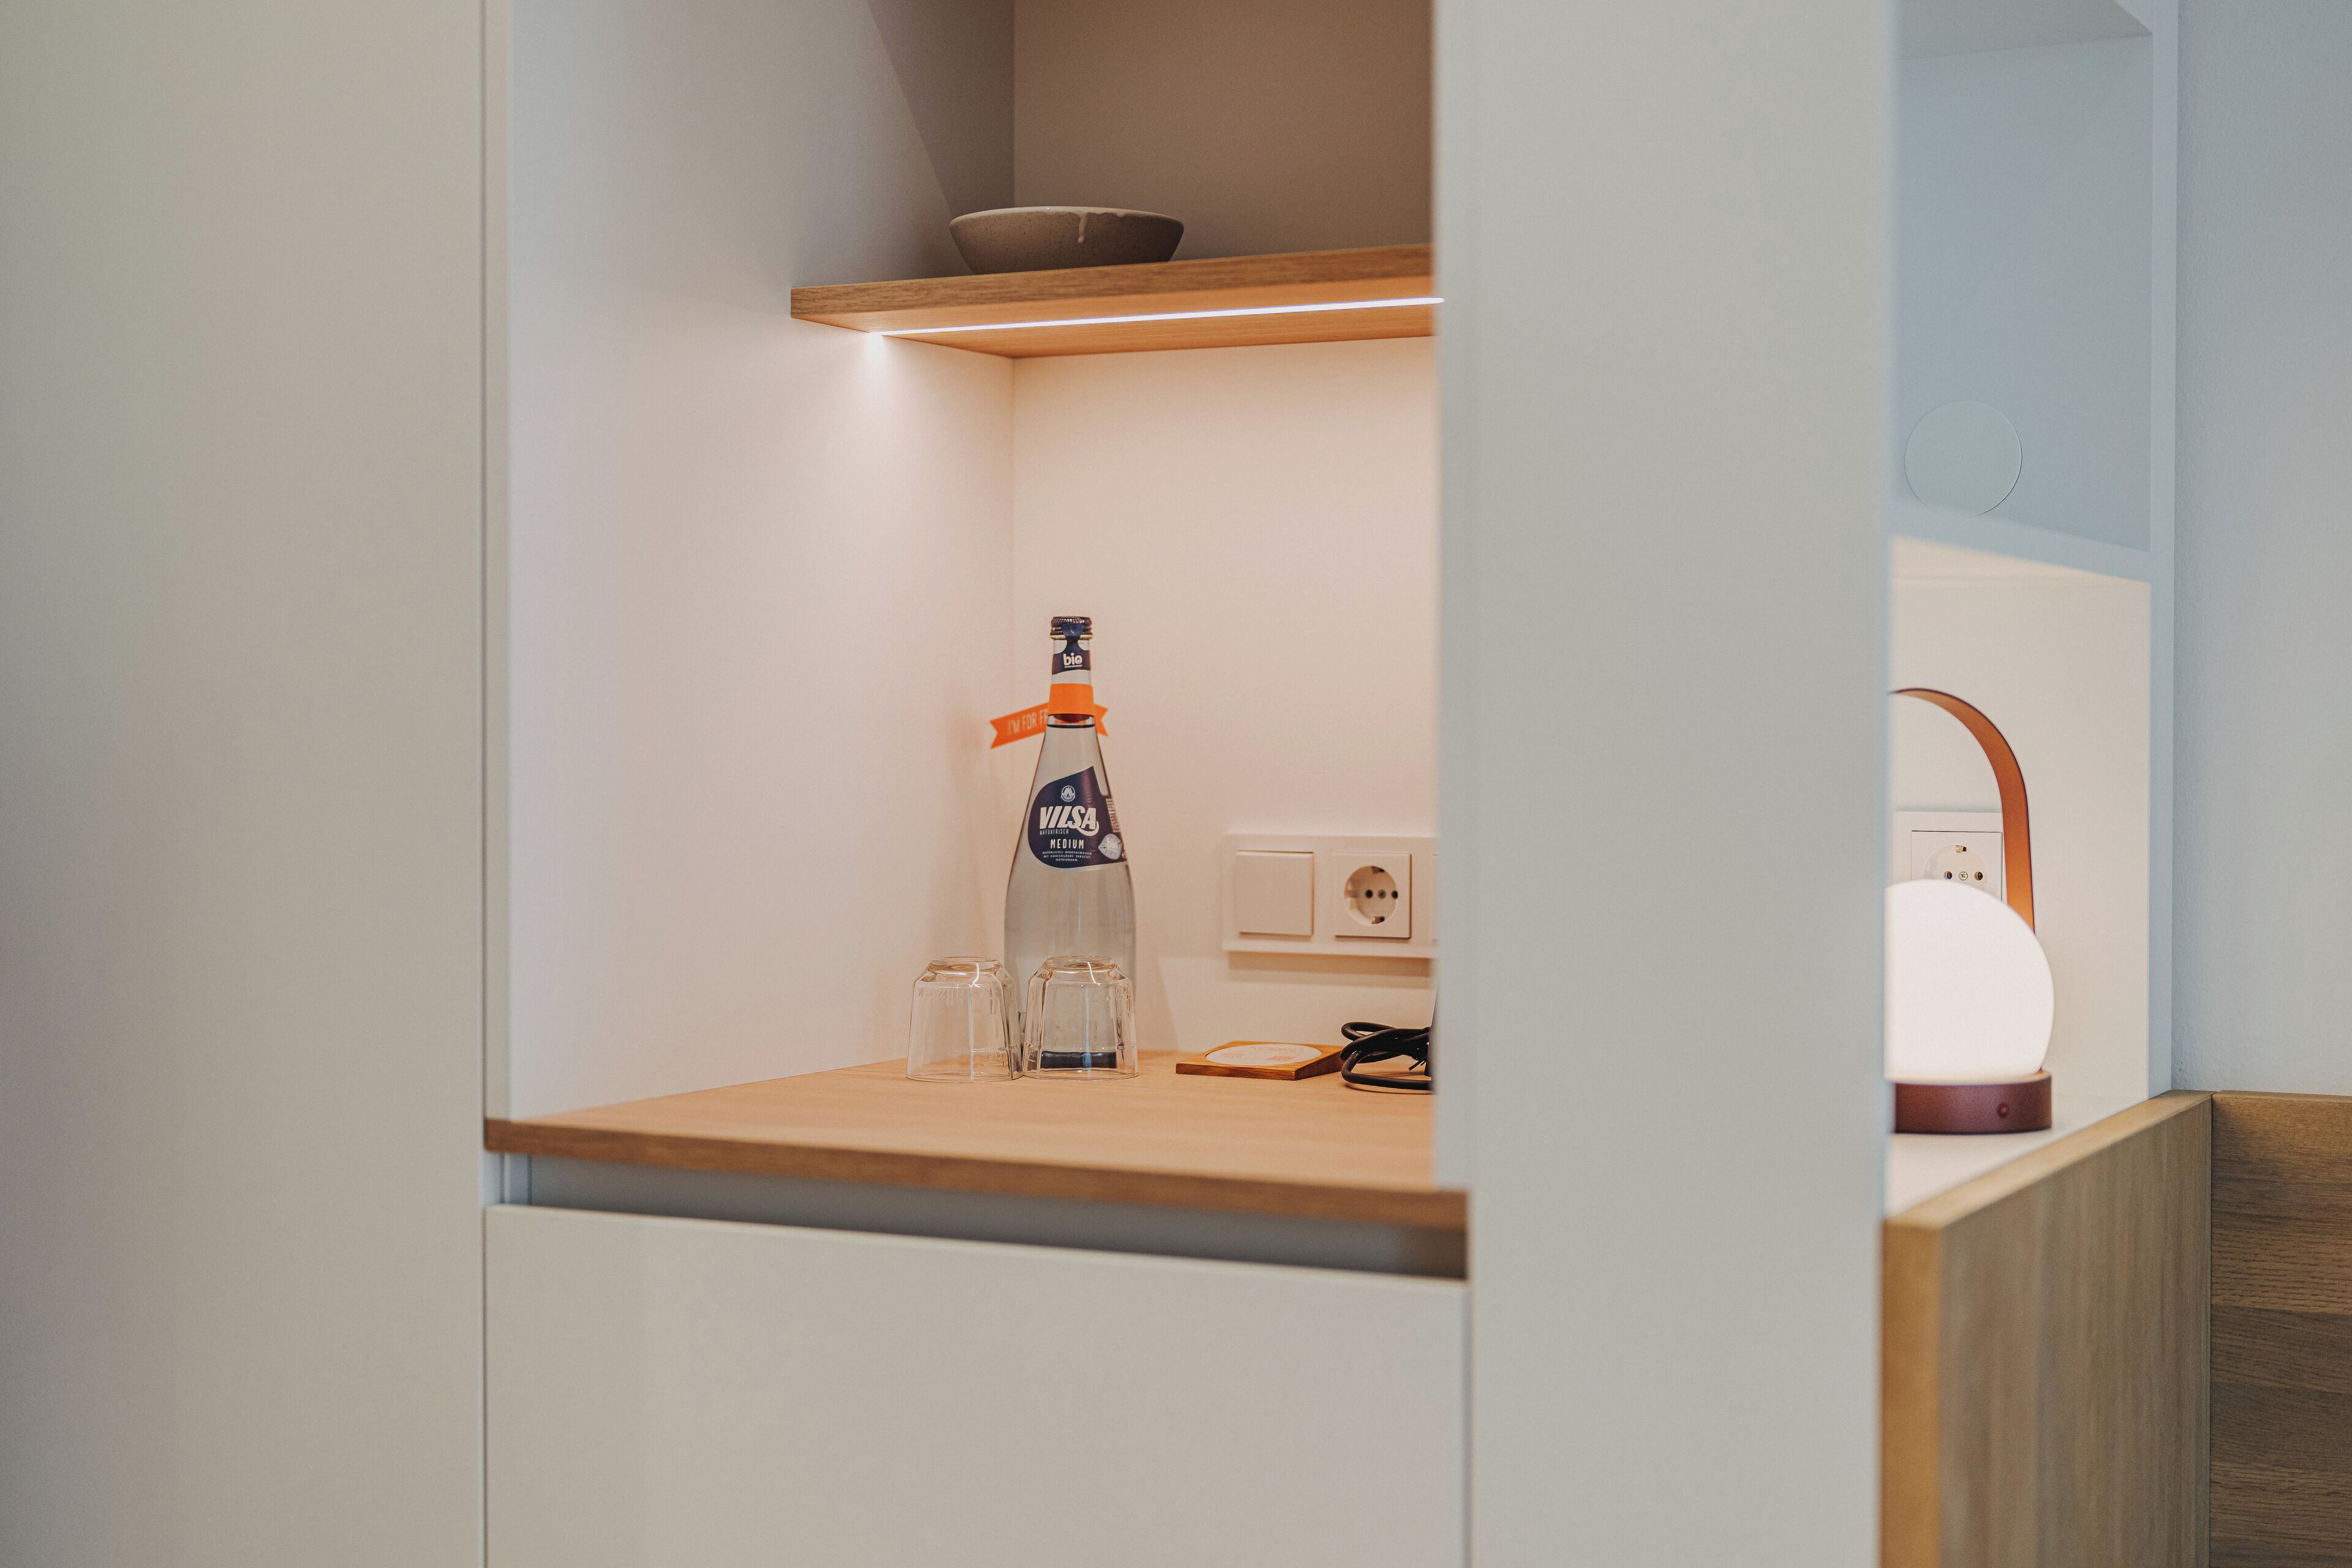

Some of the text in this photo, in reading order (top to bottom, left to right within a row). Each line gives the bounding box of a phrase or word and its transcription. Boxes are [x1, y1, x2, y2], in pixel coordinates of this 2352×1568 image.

[1063, 652, 1083, 666] bio
[1022, 712, 1037, 731] FOR
[1039, 805, 1099, 837] VILSA
[1050, 839, 1084, 849] MEDIUM
